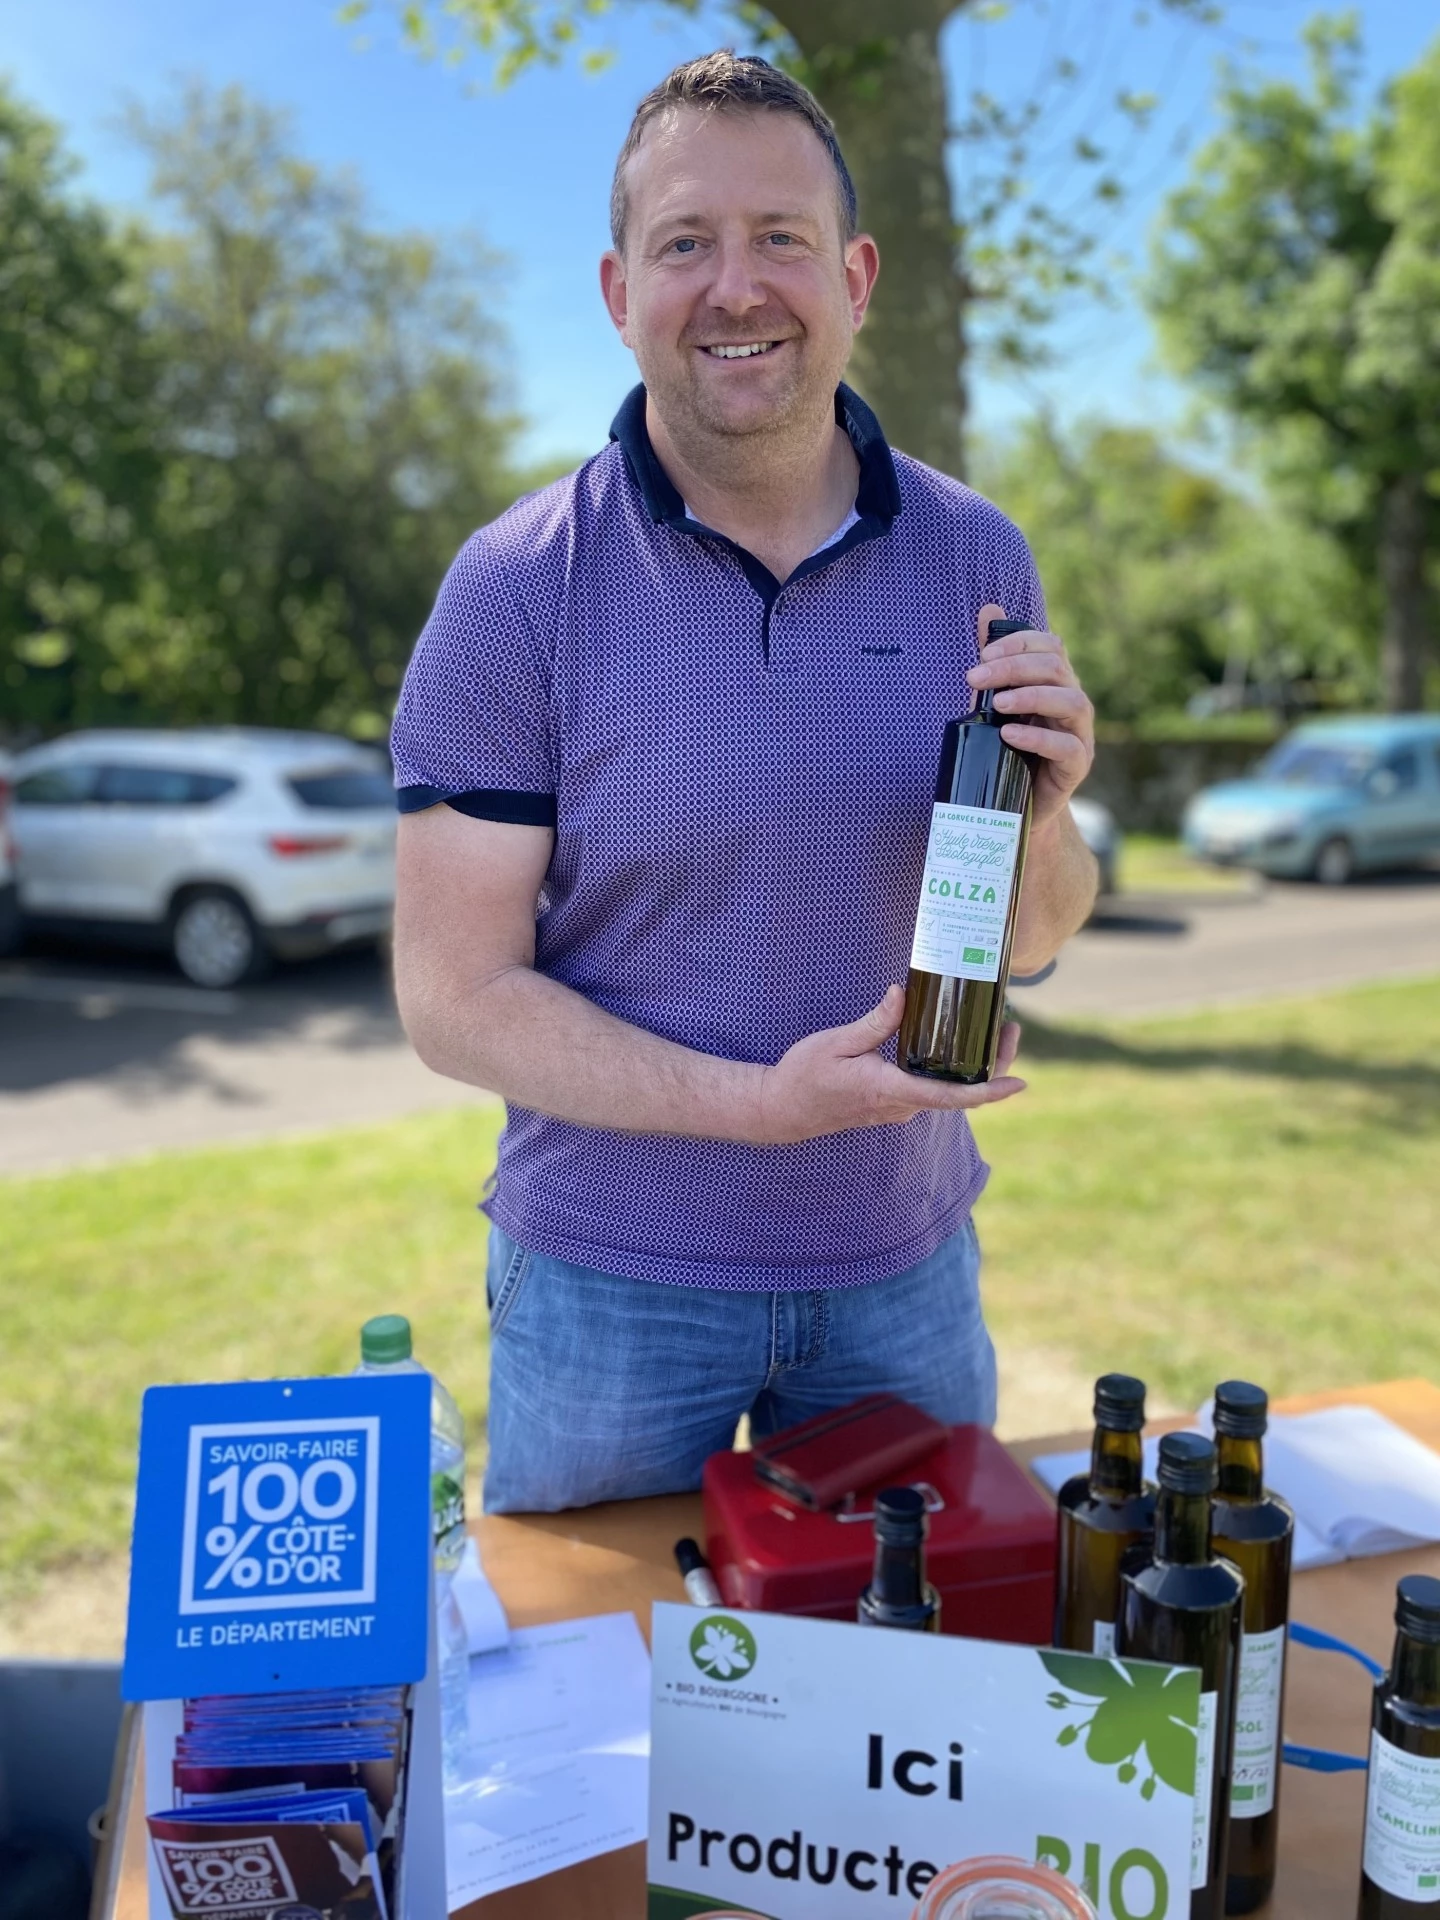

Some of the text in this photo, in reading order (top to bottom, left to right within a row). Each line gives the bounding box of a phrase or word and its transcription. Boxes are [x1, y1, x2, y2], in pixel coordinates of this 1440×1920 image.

[947, 813, 975, 823] CORVÉE
[977, 817, 987, 825] DE
[988, 819, 1016, 829] JEANNE
[935, 829, 970, 848] Huile
[928, 877, 996, 904] COLZA
[209, 1438, 359, 1464] SAVOIR-FAIRE
[207, 1458, 357, 1525] 100
[203, 1515, 356, 1590] % CÔTE-
[266, 1554, 342, 1586] D'OR
[176, 1615, 375, 1648] LE DÉPARTEMENT
[676, 1682, 768, 1704] BIO BOURGOGNE
[867, 1733, 964, 1802] Ici
[167, 1845, 267, 1861] SAVOIR-FAIRE
[668, 1811, 946, 1901] Producte
[173, 1854, 273, 1883] 100
